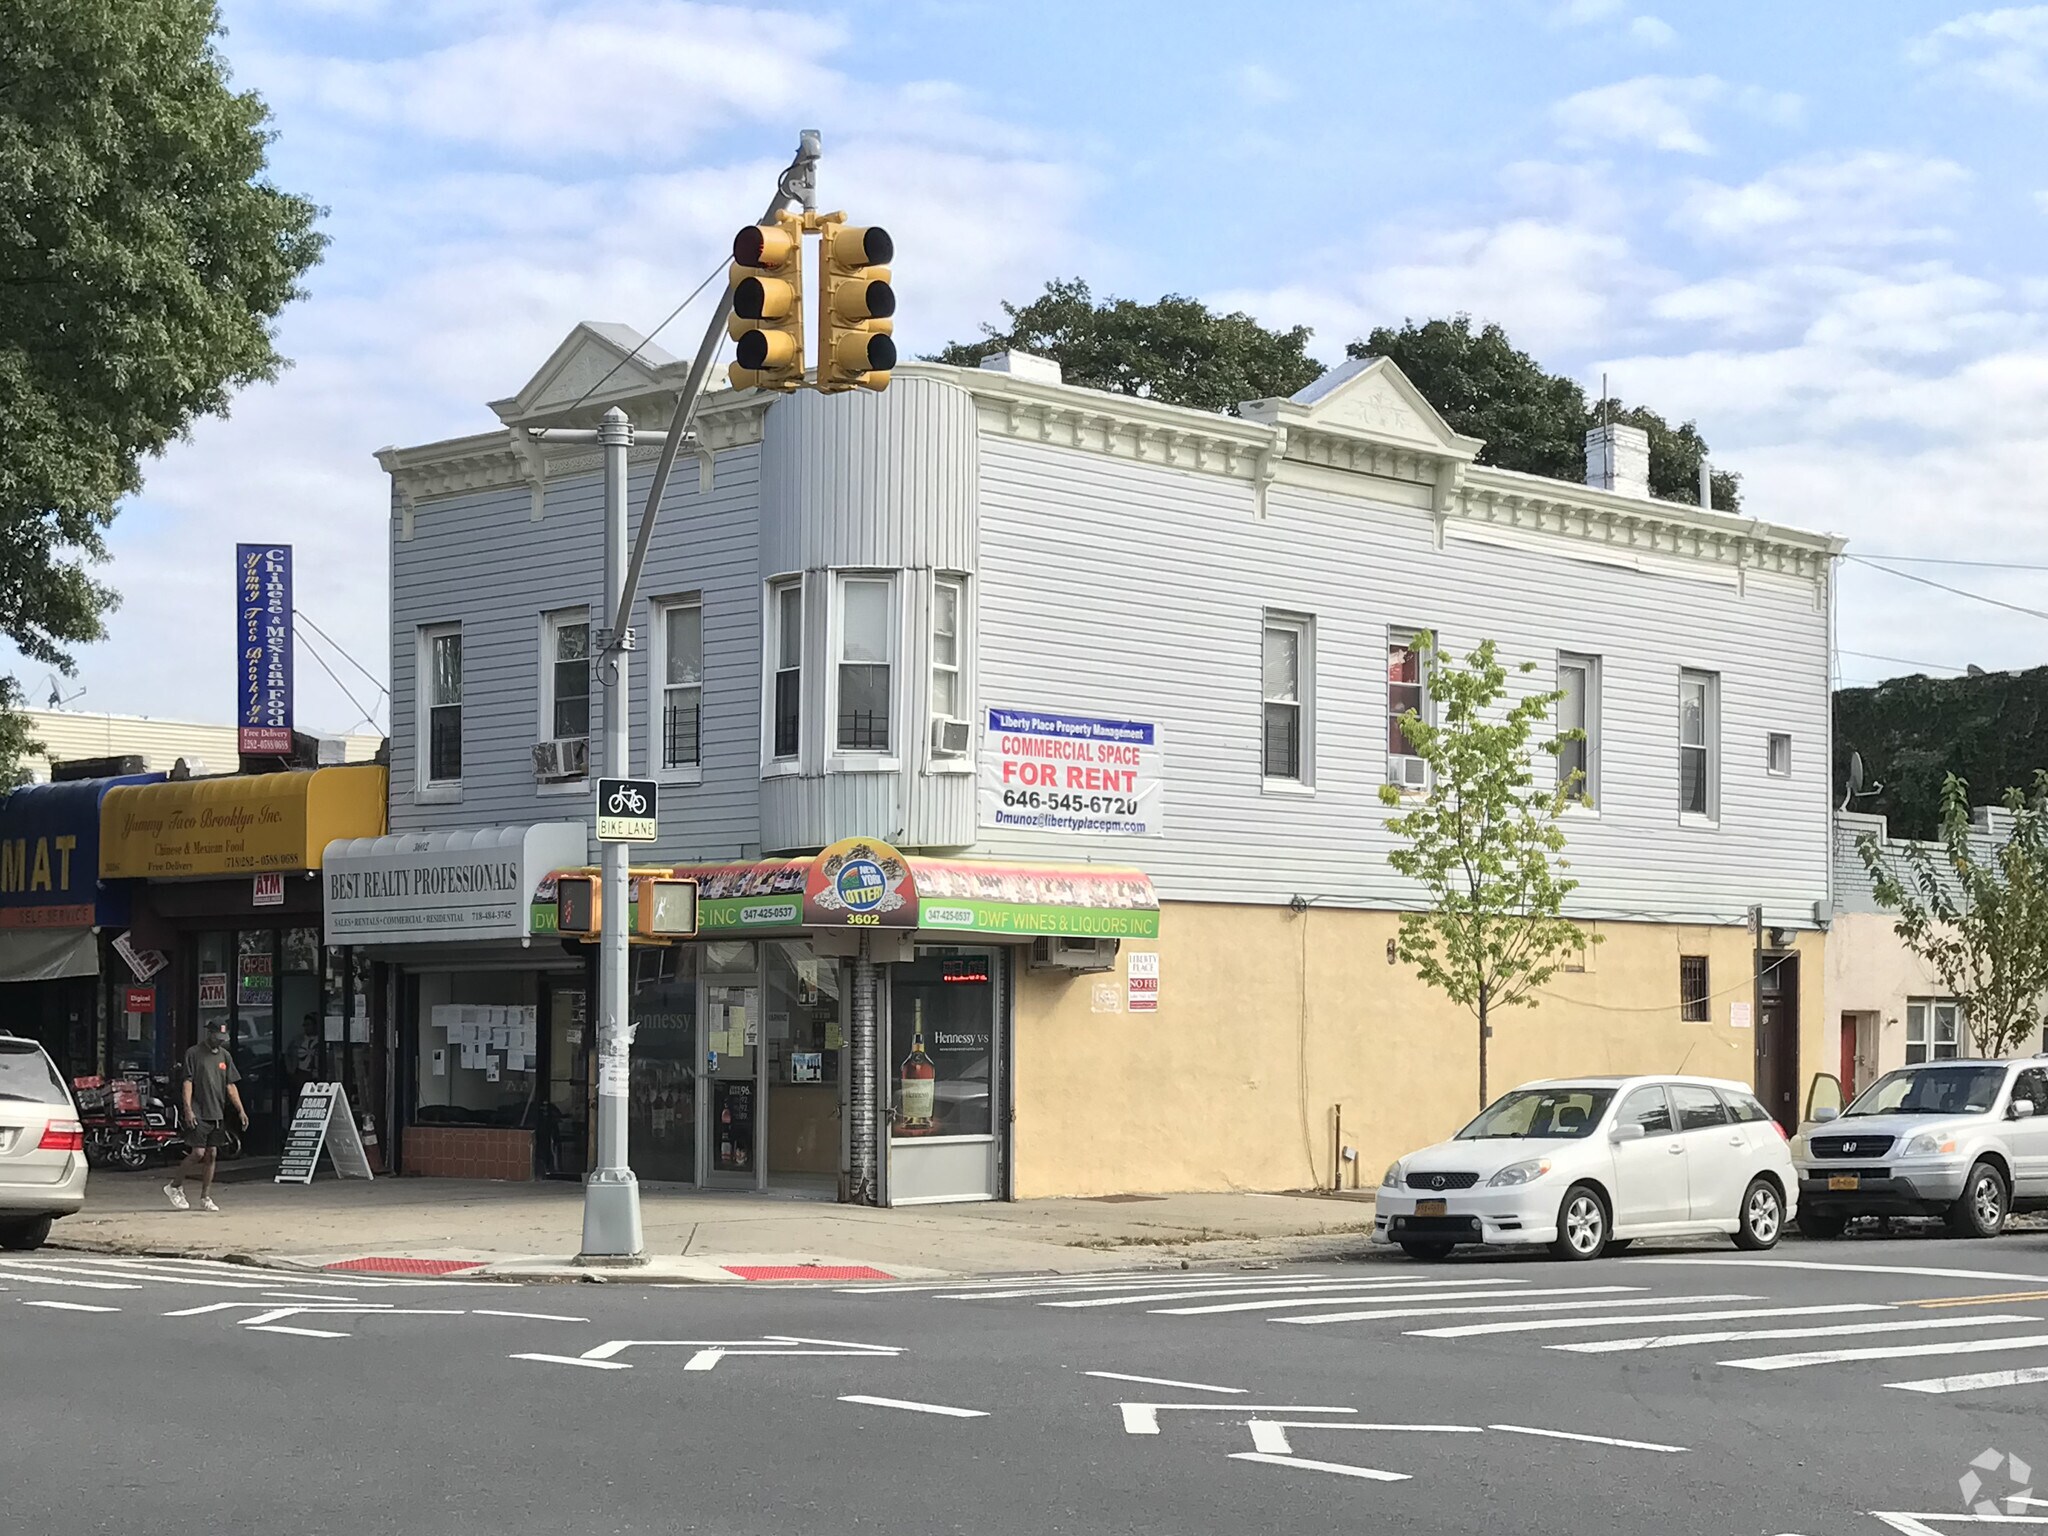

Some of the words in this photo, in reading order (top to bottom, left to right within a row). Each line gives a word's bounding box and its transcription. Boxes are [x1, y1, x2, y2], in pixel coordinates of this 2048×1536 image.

[243, 552, 262, 602] Yummy
[265, 549, 285, 614] Chinese
[243, 607, 263, 642] Taco
[271, 616, 281, 625] &
[266, 626, 286, 687] Mexican
[245, 647, 263, 724] Brooklyn
[267, 689, 285, 727] Food
[244, 729, 259, 737] Free
[261, 729, 288, 739] Delivery
[1000, 715, 1030, 731] Liberty
[1031, 717, 1055, 732] Place
[1056, 720, 1092, 738] Property
[1093, 723, 1144, 741] Management
[1001, 735, 1094, 762] COMMERCIAL
[1098, 746, 1141, 766] SPACE
[1002, 760, 1058, 787] FOR
[1067, 766, 1137, 793] RENT
[1003, 789, 1137, 816] 646-545-6720
[121, 813, 163, 840] Yummy
[168, 810, 196, 830] Taco
[200, 806, 253, 833] Brooklyn
[258, 803, 283, 824] Inc.
[601, 820, 623, 835] BIKE
[627, 821, 654, 836] LANE
[995, 810, 1146, 833] Dmunoz@libertyplacepm.com
[154, 843, 182, 857] Chinese
[183, 844, 191, 855] &
[193, 841, 223, 855] Mexican
[225, 839, 245, 853] Food
[1, 835, 77, 893] MAT
[148, 862, 163, 871] Free
[165, 861, 193, 871] Delivery
[859, 865, 877, 875] NEW
[255, 873, 281, 896] ATM
[330, 873, 361, 900] BEST
[364, 869, 411, 898] REALTY
[414, 862, 517, 896] PROFESSIONALS
[861, 874, 882, 886] YORK
[842, 885, 884, 904] LOTTERY
[334, 918, 351, 927] SALES
[354, 917, 380, 926] RENTALS
[383, 915, 423, 926] COMMERCIAL
[426, 913, 465, 924] RESIDENTIAL
[535, 913, 557, 929] DW
[709, 908, 737, 925] INC
[743, 906, 793, 920] 347-425-0537
[846, 914, 880, 925] 3602
[928, 908, 971, 922] 347-425-0537
[978, 910, 1010, 928] DWF
[1013, 913, 1056, 931] WINES
[1059, 916, 1068, 931] &
[1072, 916, 1128, 934] LIQUORS
[1131, 918, 1153, 934] INC
[200, 985, 225, 1000] ATM
[1130, 980, 1143, 988] NO
[1144, 980, 1157, 988] FEE
[934, 1031, 975, 1046] Hennessy
[301, 1097, 327, 1108] GRAND
[295, 1108, 327, 1119] OPENING
